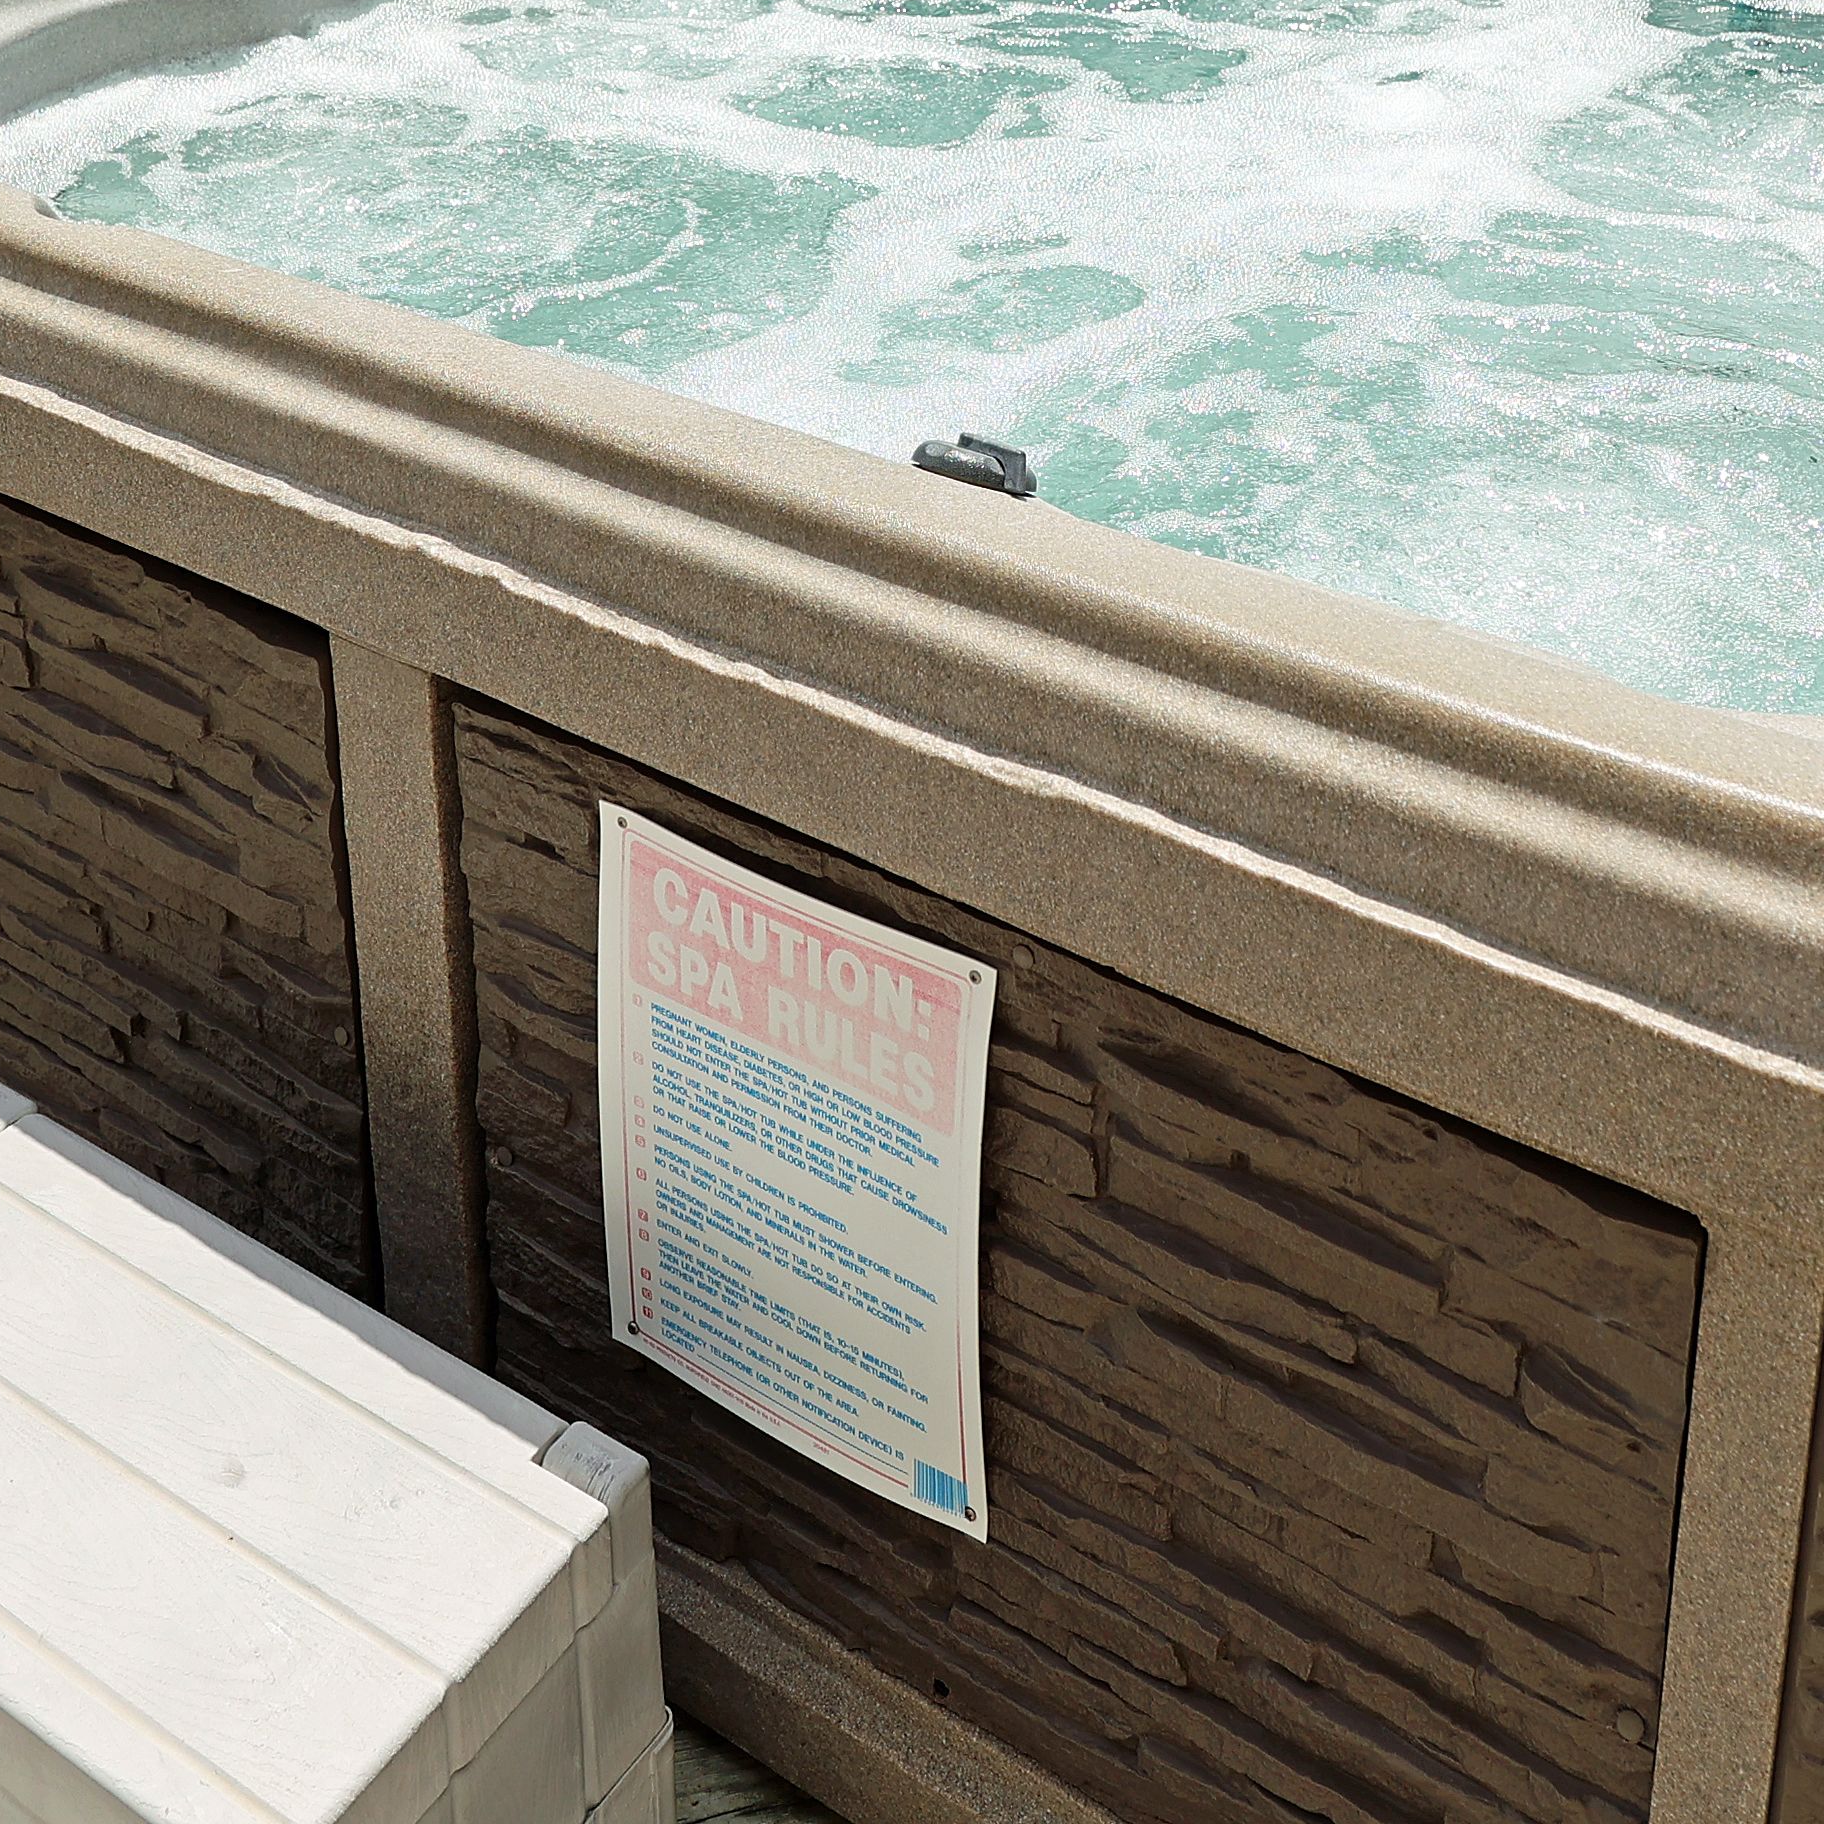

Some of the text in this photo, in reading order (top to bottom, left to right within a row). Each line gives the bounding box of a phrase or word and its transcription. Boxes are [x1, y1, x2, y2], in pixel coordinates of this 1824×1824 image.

[653, 867, 932, 1041] CAUTION:
[646, 931, 935, 1112] SPA RULES
[650, 1002, 693, 1029] PREGNANT
[730, 1040, 765, 1063] ELDERLY
[811, 1079, 830, 1094] AND
[832, 1088, 873, 1116] PERSONS
[875, 1110, 922, 1143] SUFFERING
[651, 1040, 710, 1075] CONSULTATION
[711, 1069, 729, 1084] AND
[730, 1078, 781, 1110] PERMISSION
[783, 1103, 807, 1124] FROM
[809, 1117, 834, 1137] THEIR
[651, 1015, 674, 1033] FROM
[675, 1026, 703, 1046] HEART
[788, 1081, 801, 1094] OR
[803, 1087, 824, 1106] HIGH
[826, 1099, 839, 1114] OR
[841, 1107, 861, 1124] LOW
[863, 1117, 893, 1141] BLOOD
[895, 1134, 940, 1167] PRESSURE
[651, 1028, 915, 1168] SHOULD NOT ENTER THE SPA/HOT TUB WITHOUT PRIOR MEDICAL
[652, 1104, 666, 1117] DO
[667, 1111, 684, 1126] NOT
[685, 1120, 702, 1136] USE
[652, 1085, 665, 1098] OR
[667, 1091, 686, 1108] THAT
[688, 1102, 712, 1121] RAISE
[714, 1115, 727, 1129] OR
[728, 1122, 757, 1145] LOWER
[759, 1138, 775, 1155] THE
[777, 1148, 806, 1170] BLOOD
[652, 1060, 918, 1202] DO NOT USE THE SPA/HOT TUB WHILE UNDER THE INFLUENCE OF
[653, 1124, 712, 1160] UNSUPERVISED
[714, 1155, 731, 1171] USE
[732, 1165, 744, 1177] BY
[745, 1172, 785, 1201] CHILDREN
[787, 1194, 796, 1207] IS
[654, 1155, 667, 1169] NO
[690, 1174, 712, 1193] BODY
[746, 1206, 763, 1222] AND
[807, 1239, 817, 1252] IN
[818, 1245, 836, 1262] THE
[654, 1143, 691, 1169] PERSONS
[693, 1163, 717, 1184] USING
[719, 1178, 735, 1194] THE
[736, 1188, 771, 1215] SPA/HOT
[774, 1208, 790, 1225] TUB
[792, 1219, 816, 1238] MUST
[818, 1232, 855, 1259] SHOWER
[857, 1253, 892, 1279] BEFORE
[656, 1200, 668, 1213] OR
[760, 1127, 773, 1141] OR
[775, 1135, 803, 1156] OTHER
[805, 1150, 835, 1173] DRUGS
[837, 1166, 858, 1185] THAT
[860, 1179, 889, 1202] CAUSE
[892, 1195, 948, 1235] DROWSINESS
[655, 1177, 670, 1192] ALL
[671, 1185, 709, 1213] PERSONS
[736, 1221, 752, 1238] THE
[754, 1232, 789, 1258] SPA/HOT
[792, 1252, 808, 1269] TUB
[810, 1263, 824, 1277] DO
[826, 1271, 839, 1284] SO
[841, 1280, 852, 1291] AT
[855, 1285, 879, 1307] THEIR
[881, 1301, 902, 1319] OWN
[657, 1218, 682, 1239] ENTER
[684, 1233, 701, 1248] AND
[657, 1238, 694, 1264] OBSERVE
[748, 1287, 768, 1306] TIME
[769, 1300, 796, 1322] LIMITS
[797, 1316, 821, 1335] (THAT
[836, 1337, 860, 1356] 10-15
[689, 1206, 911, 1335] AND ARE NOT FOR ACCIDENTS
[658, 1248, 929, 1405] THEN THE WATER AND COOL DOWN BEFORE RETURNING FOR
[659, 1277, 682, 1297] LONG
[682, 1289, 725, 1320] EXPOSURE
[725, 1314, 742, 1330] MAY
[744, 1325, 773, 1348] RESULT
[775, 1343, 784, 1355] IN
[871, 1397, 885, 1411] OR
[660, 1296, 681, 1314] KEEP
[682, 1310, 697, 1324] ALL
[698, 1318, 744, 1352] BREAKABLE
[784, 1368, 801, 1384] OUT
[803, 1379, 815, 1391] OF
[817, 1386, 833, 1403] THE
[661, 1327, 695, 1353] LOCATED
[661, 1316, 707, 1349] EMERGENCY
[709, 1343, 754, 1377] TELEPHONE
[755, 1371, 771, 1387] (OR
[772, 1382, 800, 1404] OTHER
[801, 1398, 856, 1436] NOTIFICATION
[858, 1430, 893, 1456] DEVICE)
[895, 1449, 904, 1461] IS
